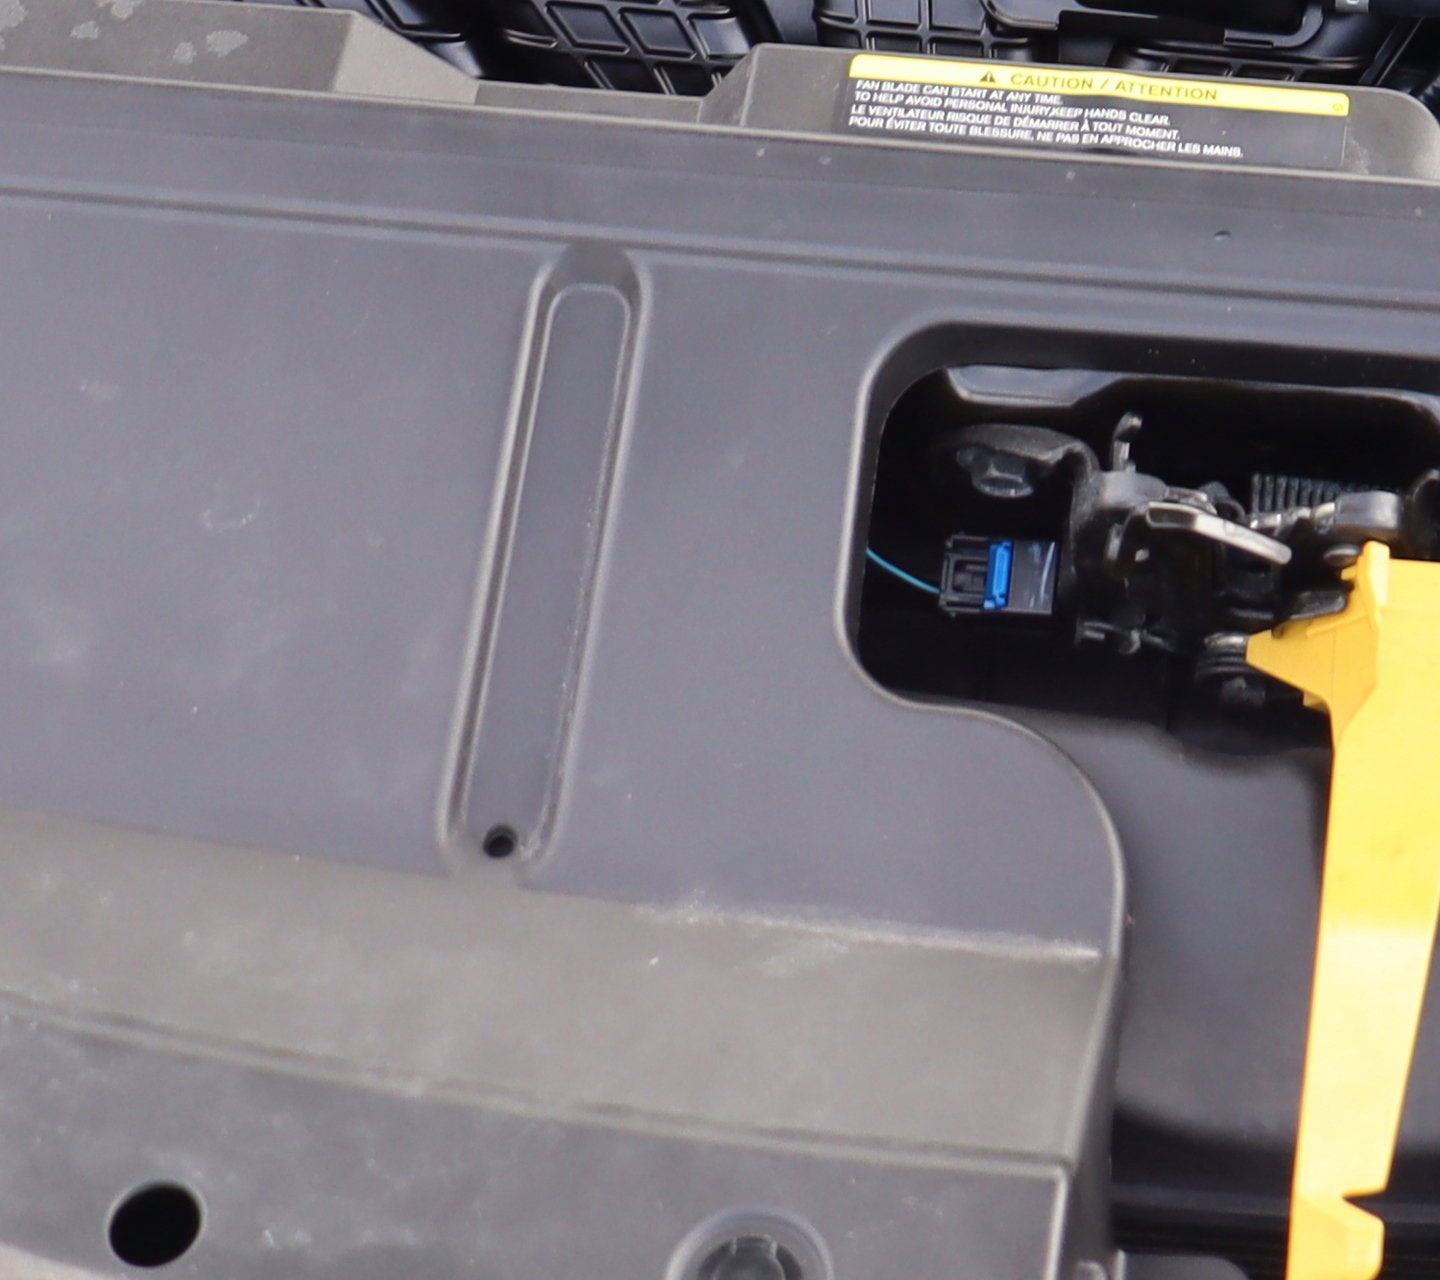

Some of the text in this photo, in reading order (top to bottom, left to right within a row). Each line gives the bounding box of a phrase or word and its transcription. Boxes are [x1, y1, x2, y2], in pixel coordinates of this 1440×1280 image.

[855, 80, 1063, 105] FAN BLADE CAN START AT ANY TIME.
[1010, 73, 1094, 90] CAUTION
[1115, 79, 1218, 101] ATTENTION
[851, 104, 1180, 140] LE VENTILATEUR RISQUE DE DÉMARRER À TOUT MOMENT.
[854, 90, 870, 103] TO
[872, 92, 904, 104] HELP
[905, 95, 942, 108] AVOID
[943, 98, 1008, 113] PERSONAL
[1084, 108, 1127, 121] HANDS
[1129, 112, 1171, 126] CLEAR.
[848, 116, 1244, 158] POUR ÉVITER TOUTE BLESSURE, NE PAS EN APPROCHER LES MAINS.
